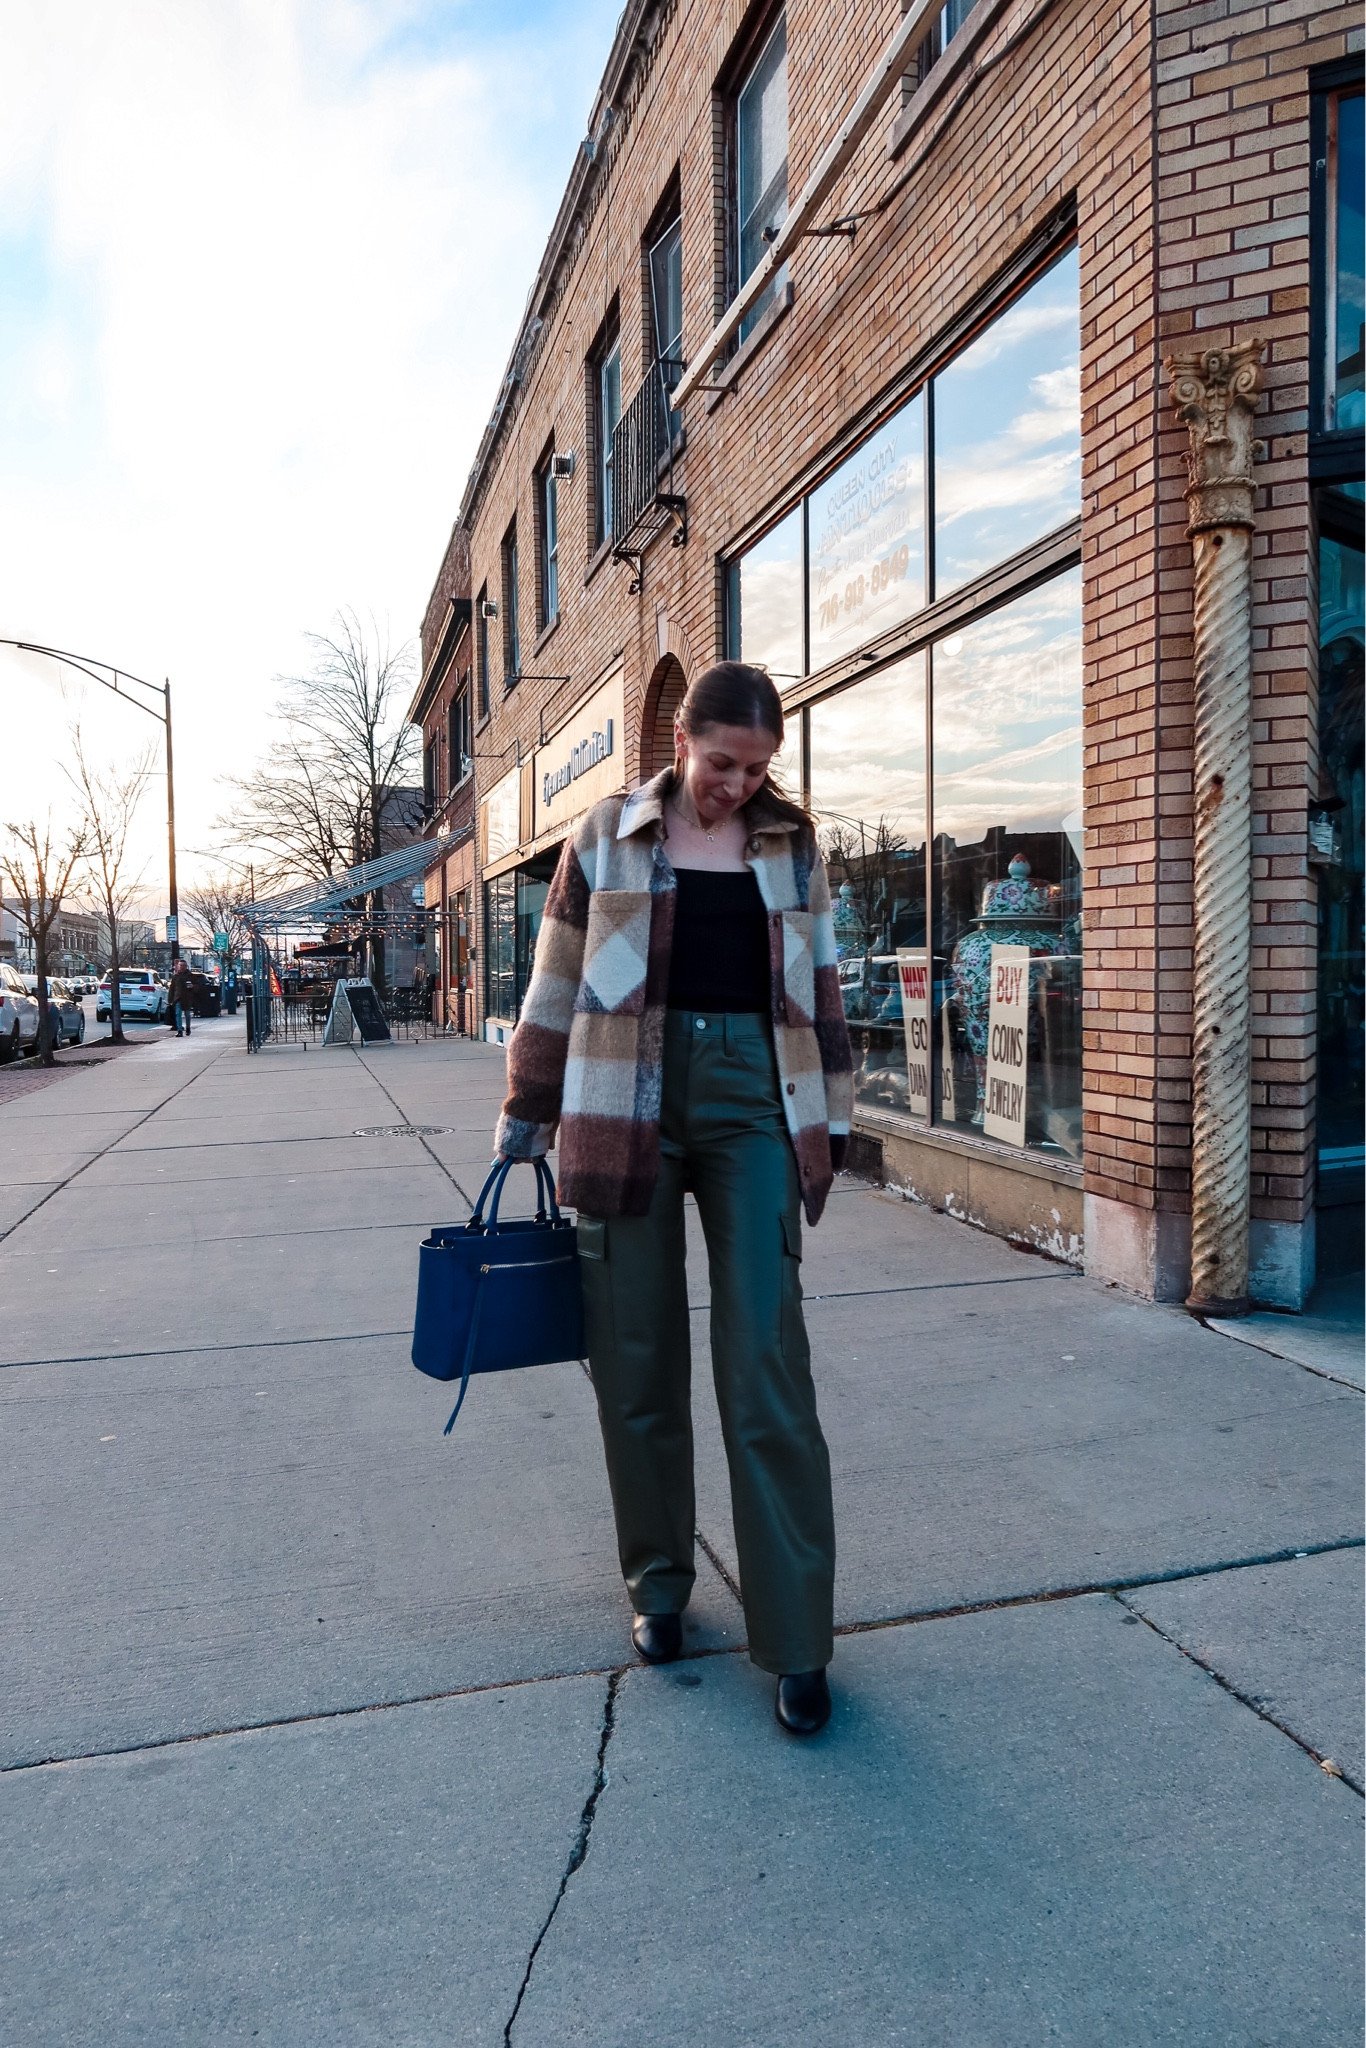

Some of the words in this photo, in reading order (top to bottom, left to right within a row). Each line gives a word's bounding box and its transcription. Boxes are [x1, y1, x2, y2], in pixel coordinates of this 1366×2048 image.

[821, 464, 908, 556] ANTIQUES
[828, 469, 866, 519] QUEEN
[819, 544, 908, 630] 716-913-8549
[996, 965, 1023, 1006] BUY
[911, 1017, 929, 1050] GO
[991, 1023, 1024, 1067] COINS
[985, 1076, 1024, 1123] JEWELRY
